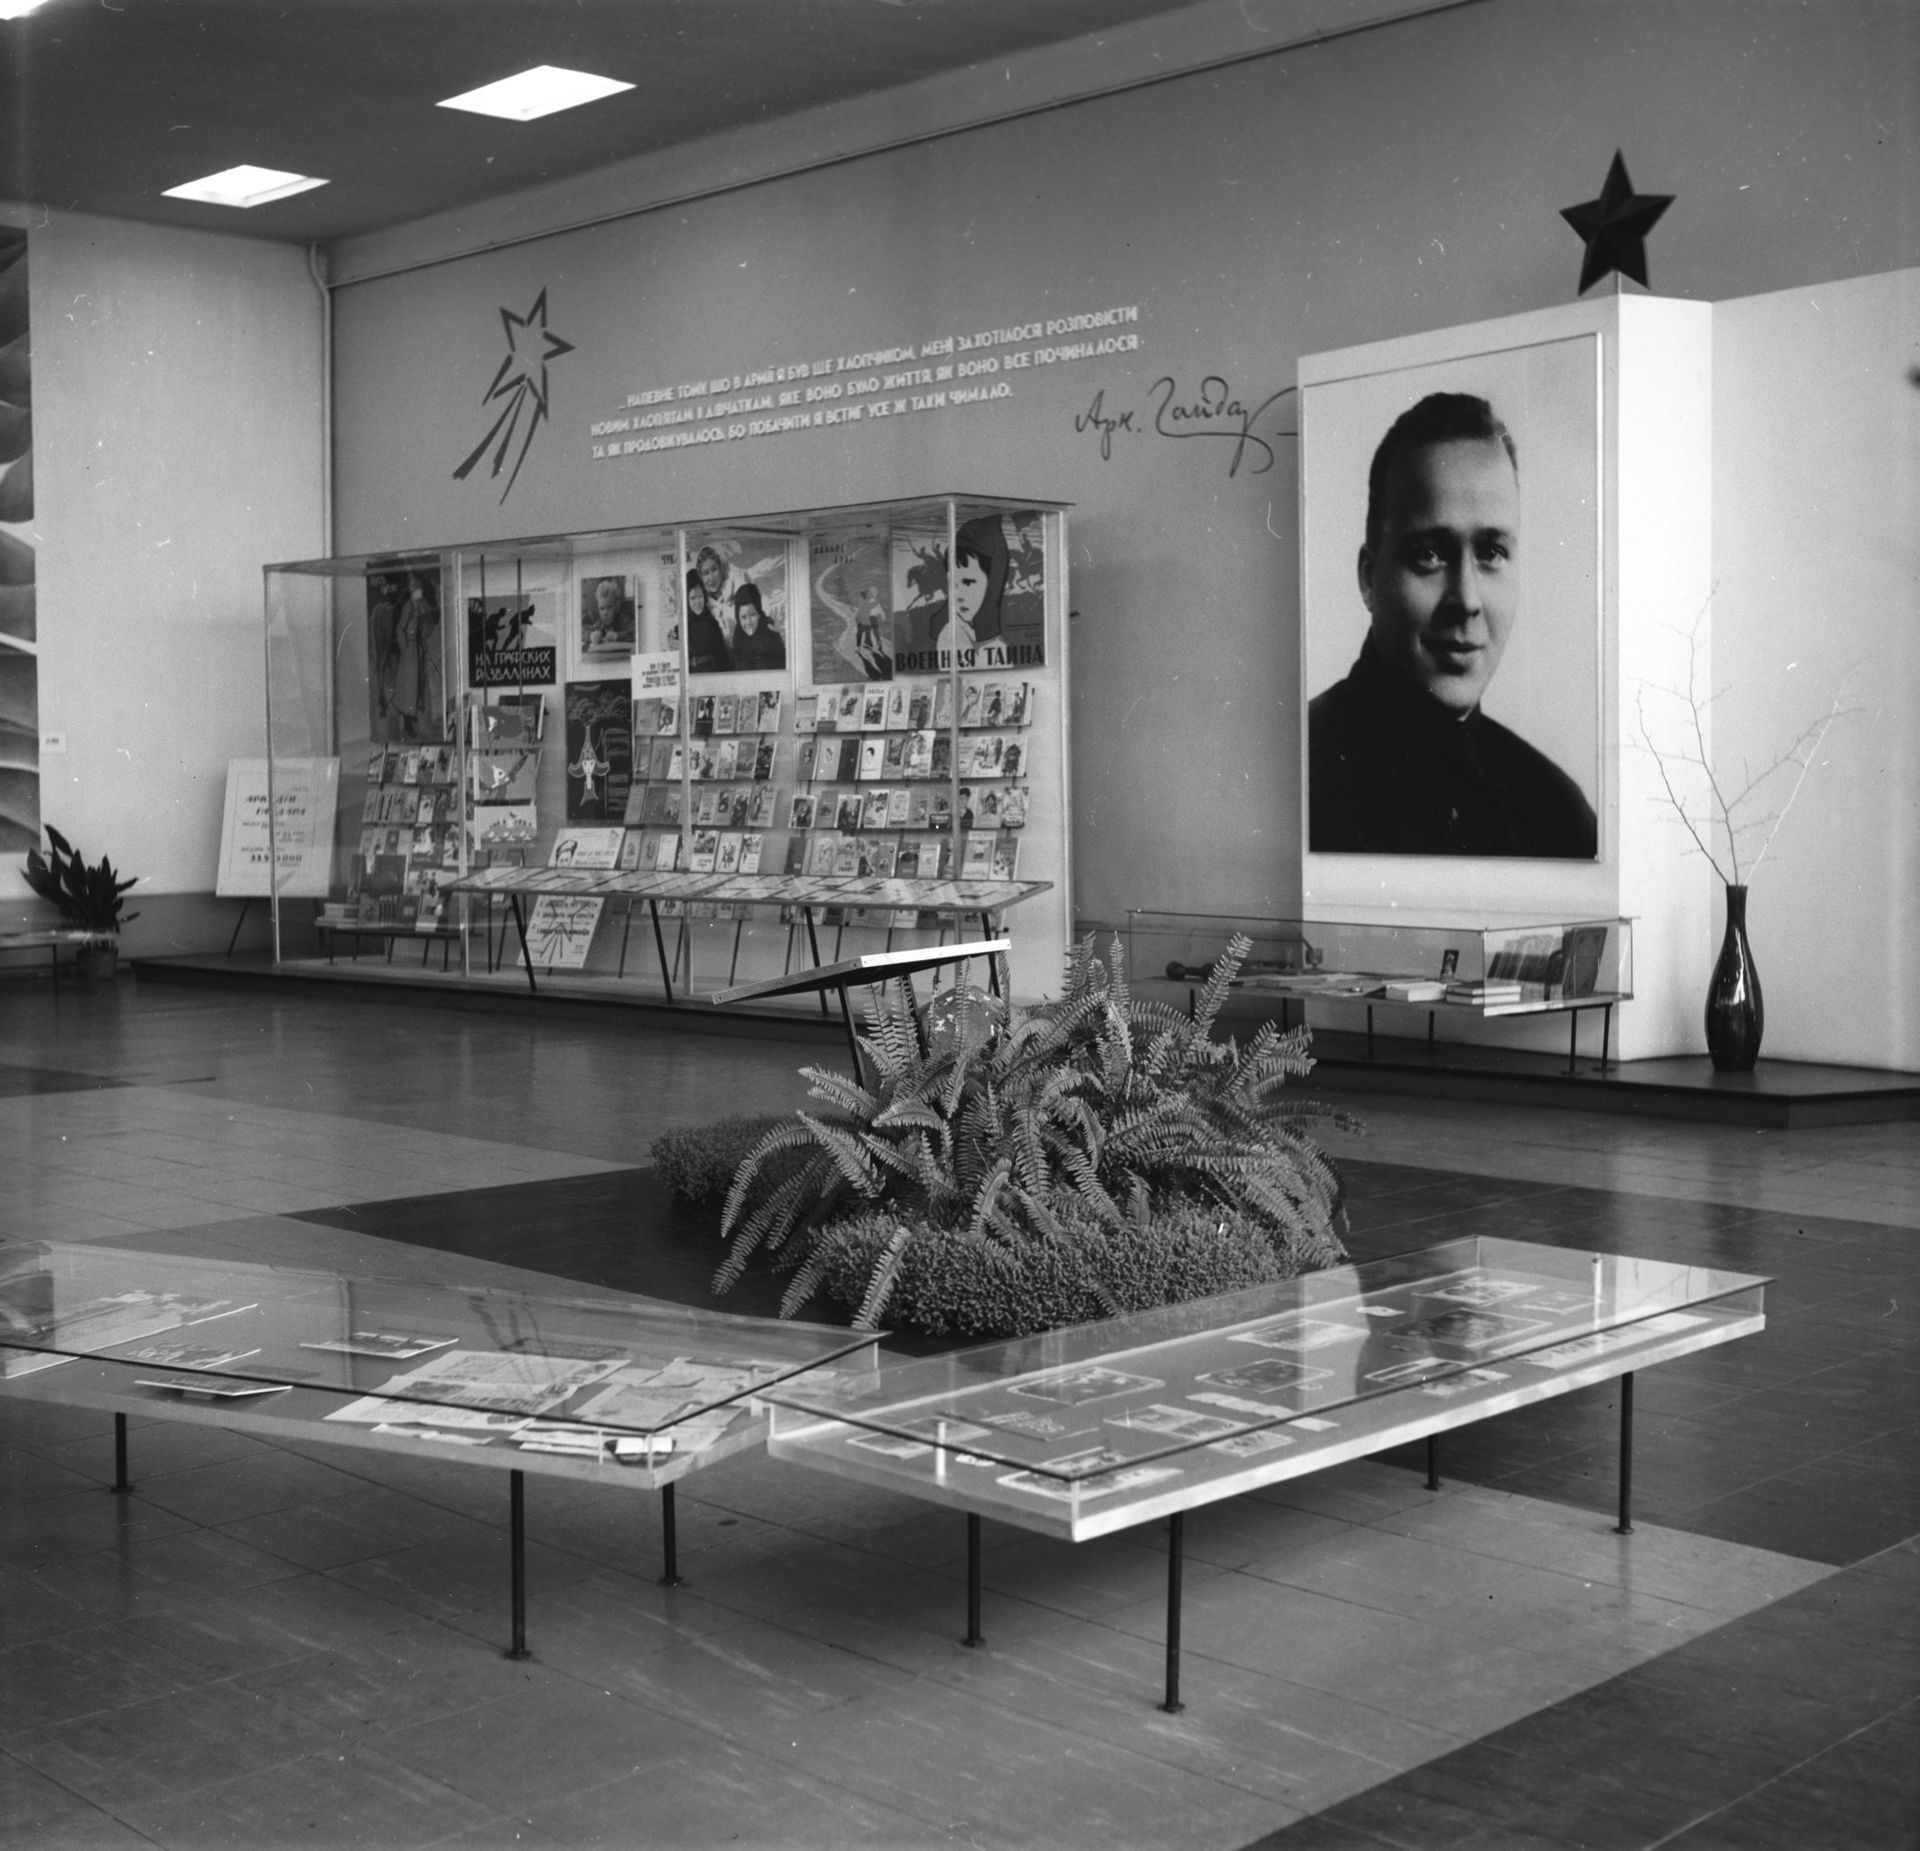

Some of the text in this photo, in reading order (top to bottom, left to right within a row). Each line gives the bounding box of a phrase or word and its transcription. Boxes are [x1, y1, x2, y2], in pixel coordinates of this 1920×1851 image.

[733, 375, 742, 390] В
[776, 367, 785, 384] Я
[787, 363, 810, 381] БУВ
[957, 322, 1043, 351] ЗАХОТІЛОСЯ
[1046, 306, 1138, 336] РОЗПОВІСТИ
[590, 418, 630, 438] НОВИМ
[779, 390, 802, 408] ЯКЕ
[805, 383, 843, 402] ВОНО
[847, 377, 880, 396] БУЛО
[935, 364, 954, 381] ЯК
[958, 357, 999, 378] ВОНО
[1003, 351, 1031, 370] ВСЕ
[1034, 334, 1138, 366] ПОЧИНАЛОСЯ
[592, 445, 605, 460] ТА
[607, 442, 621, 458] ЯК
[727, 423, 746, 440] БО
[748, 413, 811, 436] ПОБАЧИТИ
[813, 411, 823, 427] Я
[825, 404, 865, 425] ВСТИГ
[866, 401, 891, 418] УСЕ
[892, 398, 907, 415] Ж
[909, 391, 946, 411] ТАКИ
[475, 652, 492, 667] НА
[984, 643, 1044, 666] ТАЙНА
